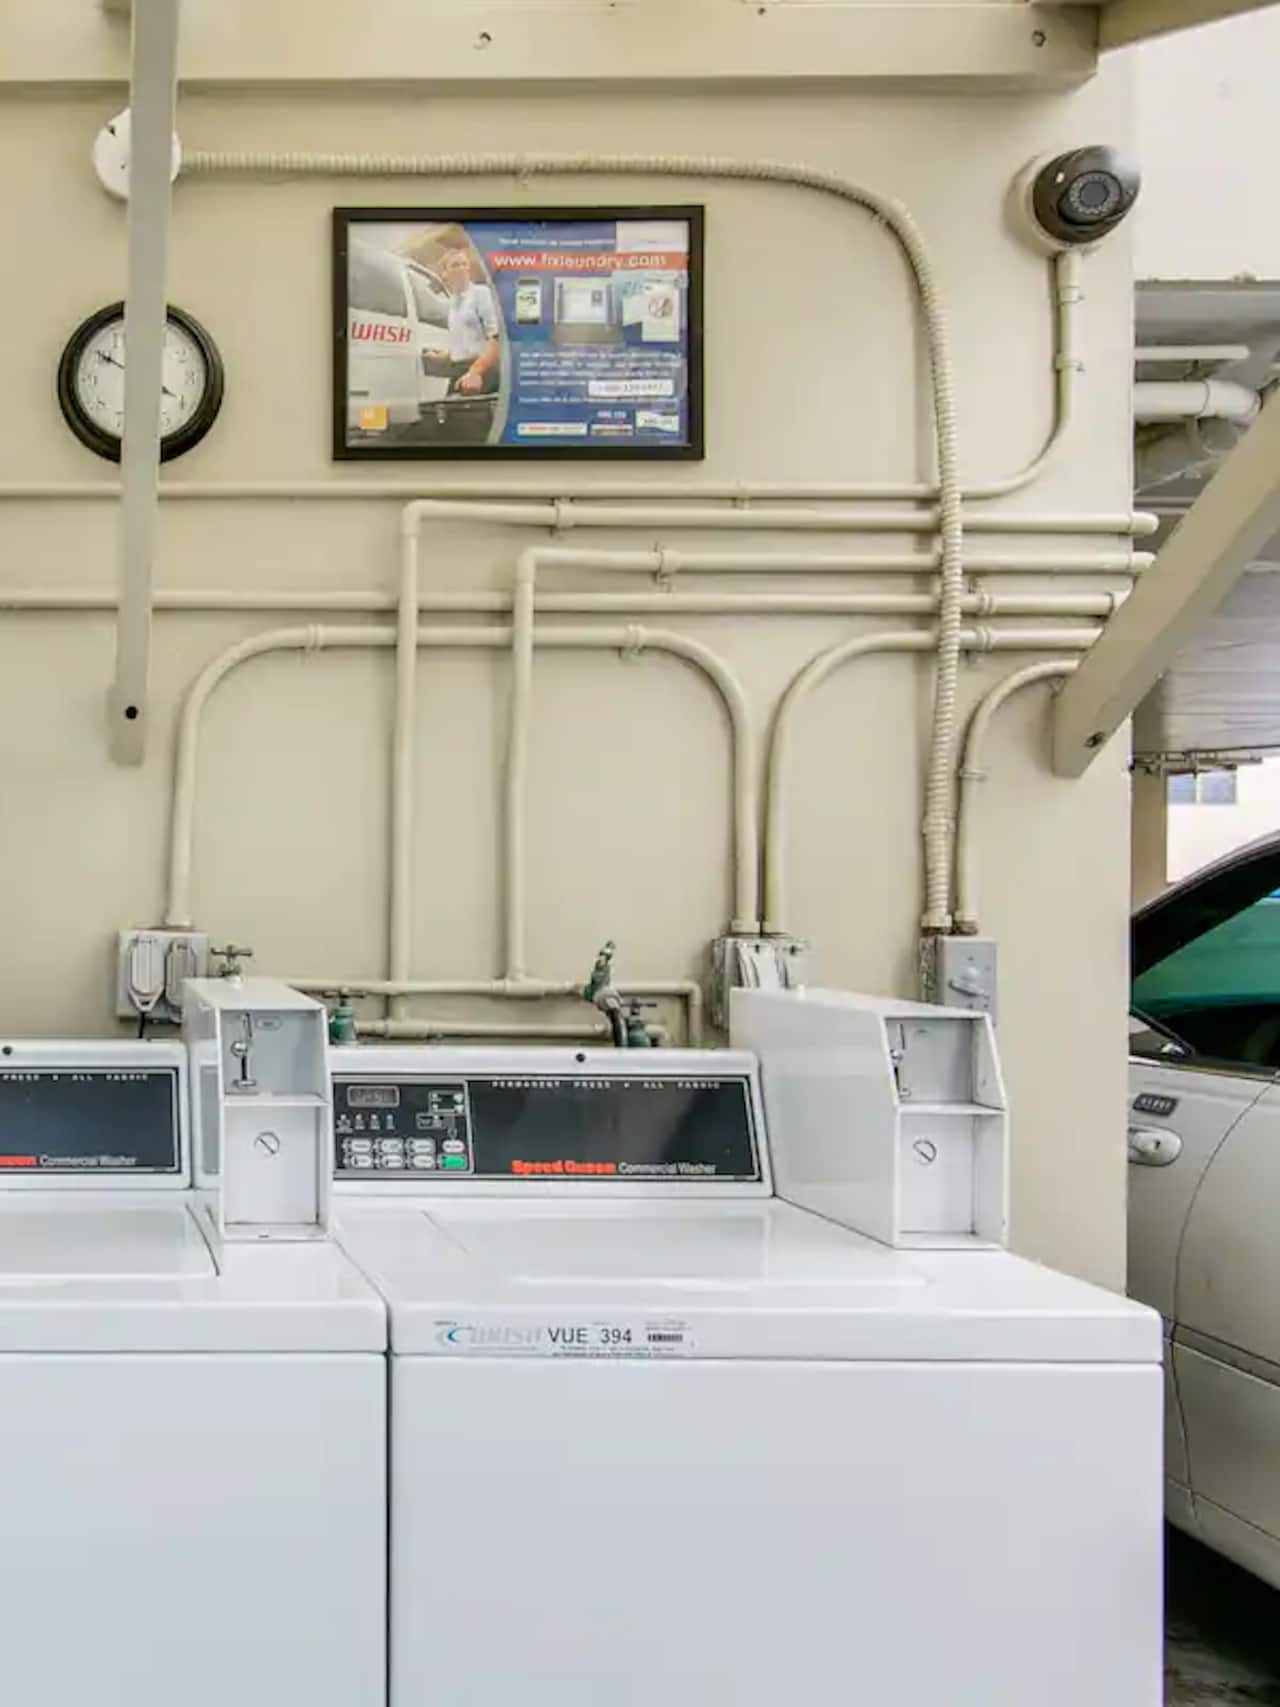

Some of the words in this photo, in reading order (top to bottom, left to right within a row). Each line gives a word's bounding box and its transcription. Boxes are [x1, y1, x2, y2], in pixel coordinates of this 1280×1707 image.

[350, 321, 412, 343] WASH
[491, 1080, 561, 1088] PERMANENT
[39, 1154, 98, 1167] Commercial
[511, 1160, 564, 1175] Speed
[564, 1160, 617, 1174] Queen
[618, 1161, 678, 1175] Commercial
[678, 1162, 717, 1175] Washer
[547, 1327, 589, 1344] VUE
[600, 1327, 633, 1344] 394
